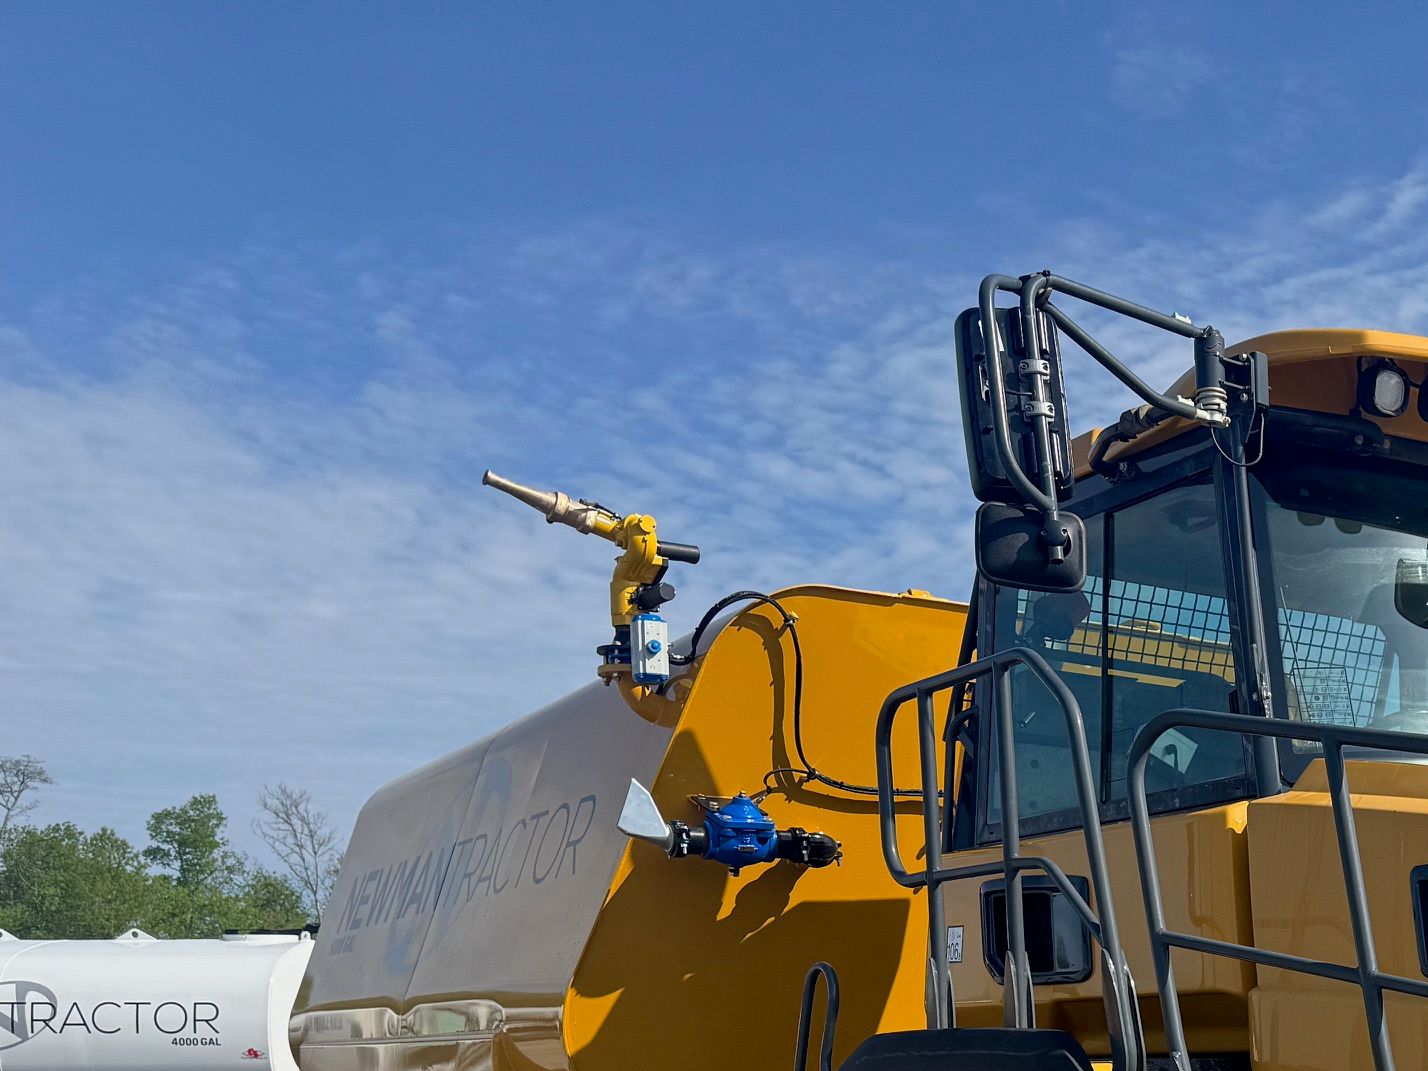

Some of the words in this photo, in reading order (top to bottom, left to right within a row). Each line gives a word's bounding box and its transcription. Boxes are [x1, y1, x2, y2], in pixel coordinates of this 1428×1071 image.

[0, 1001, 220, 1034] TRACTOR
[171, 1037, 199, 1046] 4000
[200, 1037, 222, 1046] GAL
